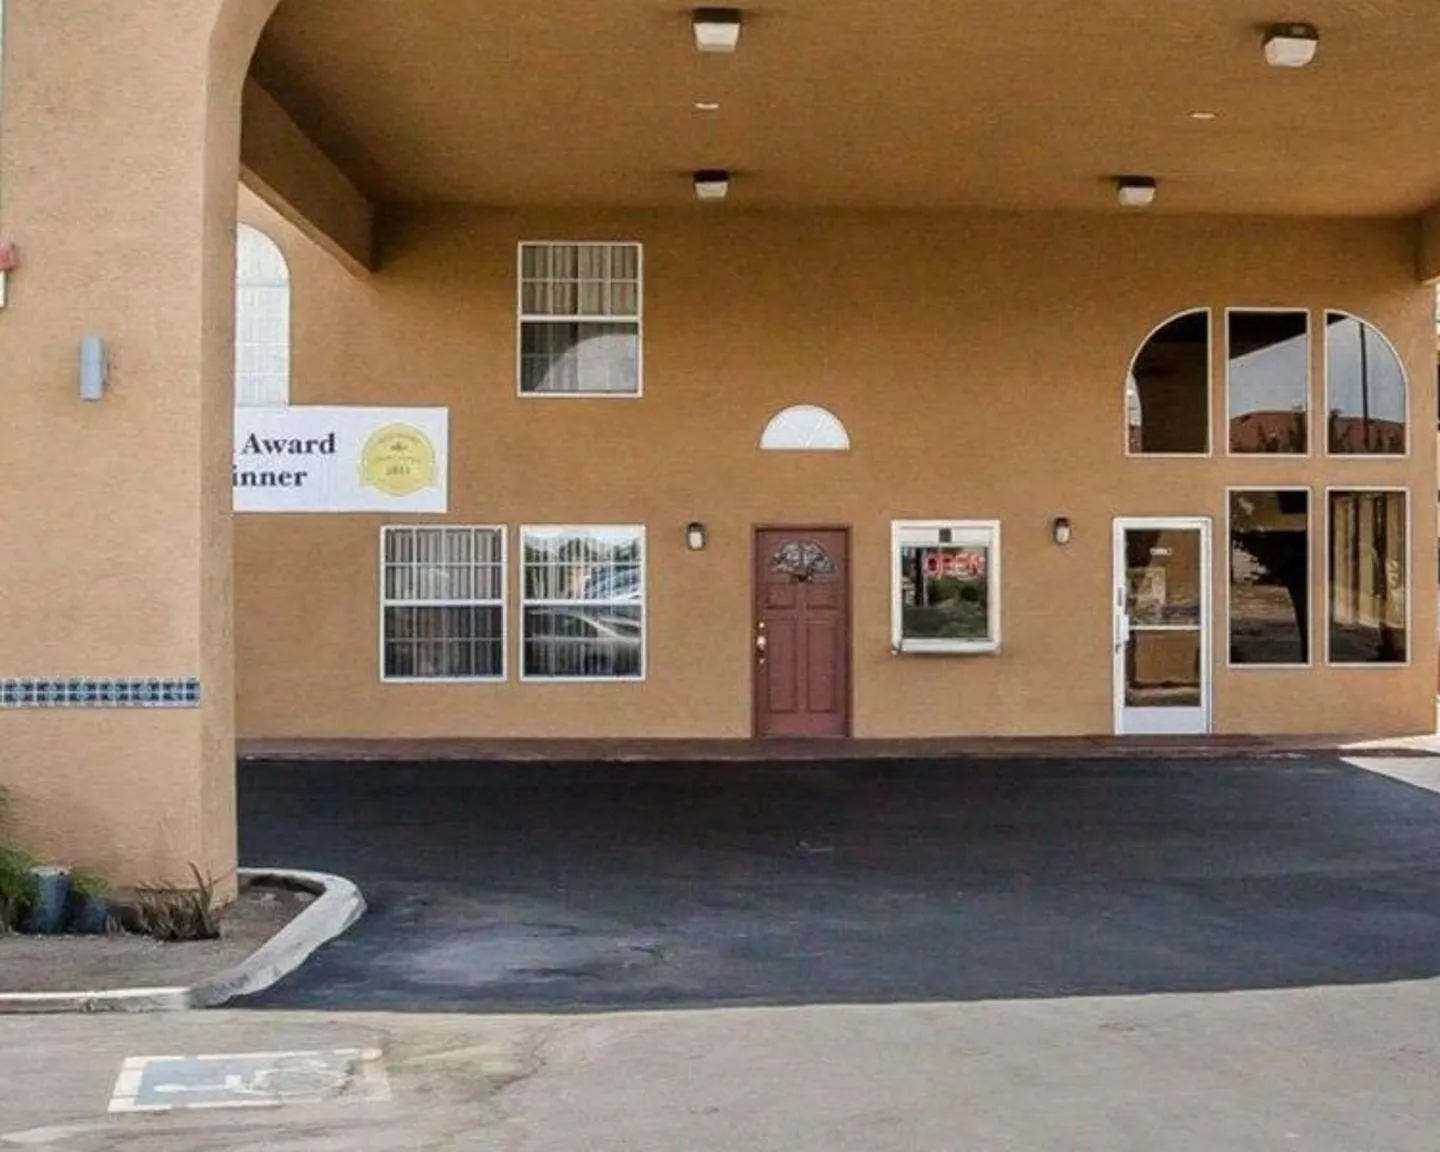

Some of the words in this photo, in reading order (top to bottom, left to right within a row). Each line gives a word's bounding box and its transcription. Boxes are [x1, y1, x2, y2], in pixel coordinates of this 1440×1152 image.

[241, 432, 336, 455] Award
[232, 464, 308, 487] inner
[922, 553, 985, 577] OPEN
